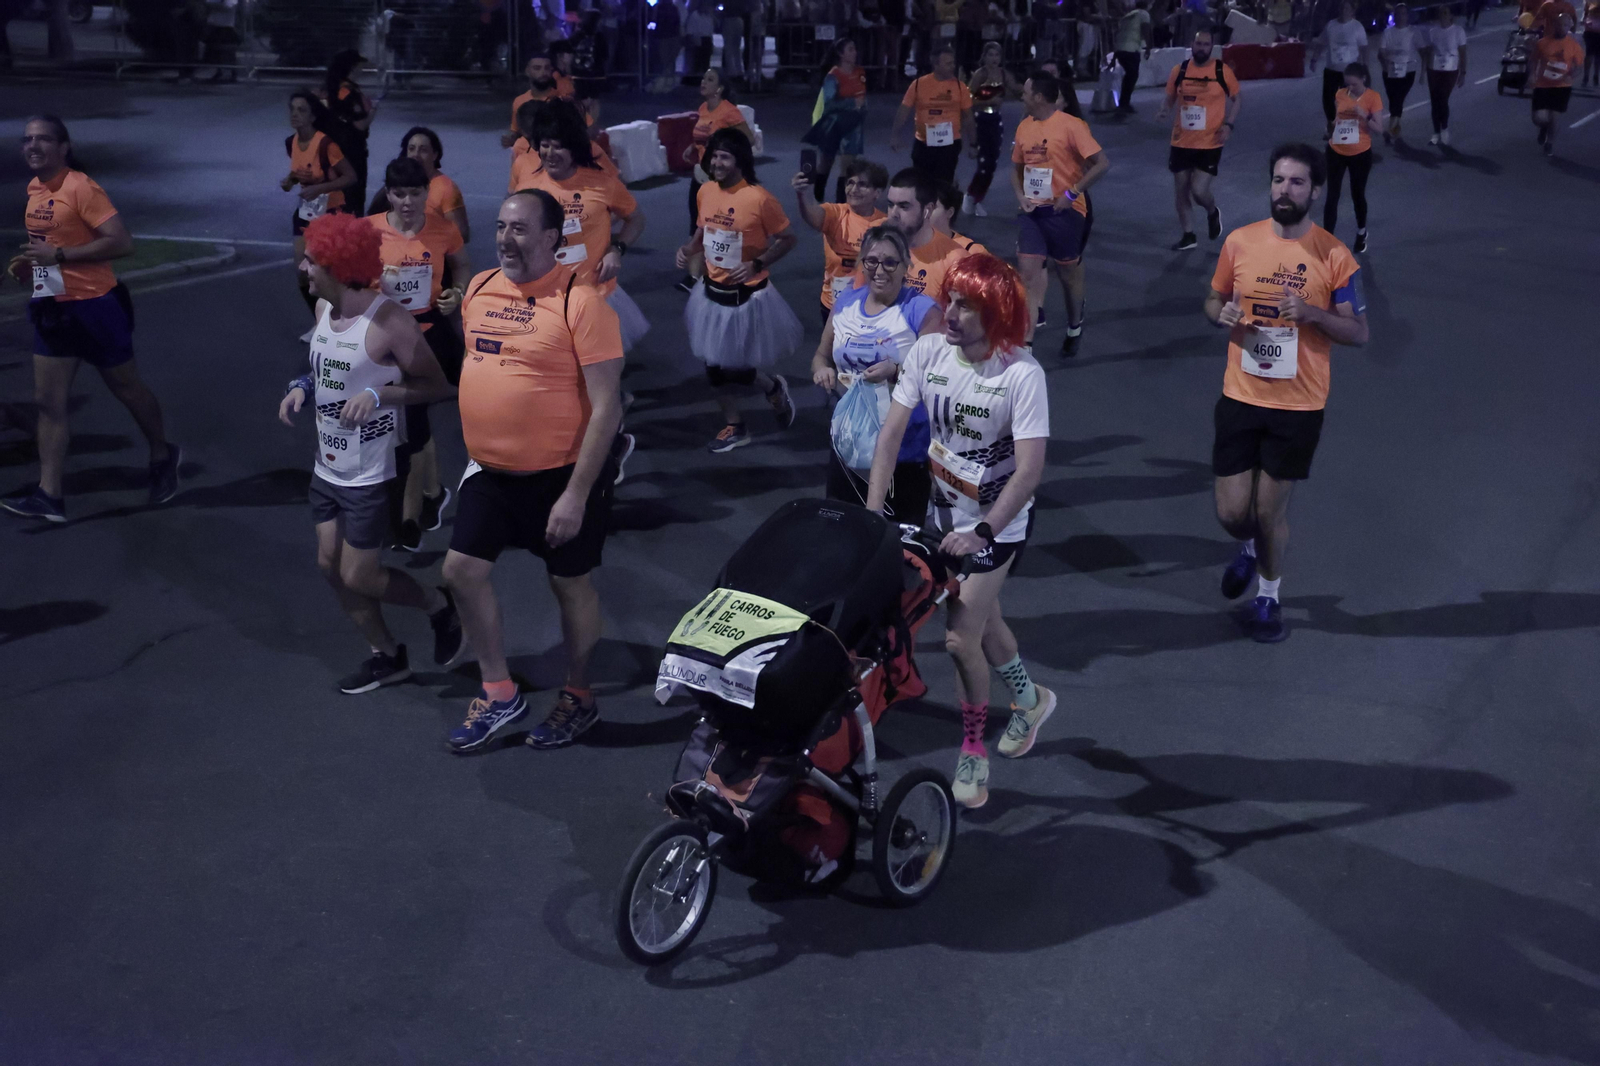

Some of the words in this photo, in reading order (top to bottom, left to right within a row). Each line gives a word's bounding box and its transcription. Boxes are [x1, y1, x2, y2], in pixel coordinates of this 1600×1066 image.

[712, 240, 731, 253] 7597
[31, 266, 49, 279] 125
[1272, 272, 1307, 283] NOCTURNA
[394, 280, 420, 293] 4304
[485, 310, 514, 321] SEVILLA
[503, 306, 536, 318] NOCTURNA
[1253, 343, 1282, 358] 4600
[323, 358, 351, 372] CARROS
[323, 368, 331, 378] DE
[321, 378, 345, 391] FUEGO
[955, 402, 990, 419] CARROS
[954, 414, 965, 425] DE
[956, 425, 982, 441] FUEGO
[942, 468, 964, 493] 1323
[971, 556, 993, 566] evilla
[730, 599, 776, 620] CARROS
[718, 610, 737, 623] DE
[707, 622, 746, 641] FUEGO
